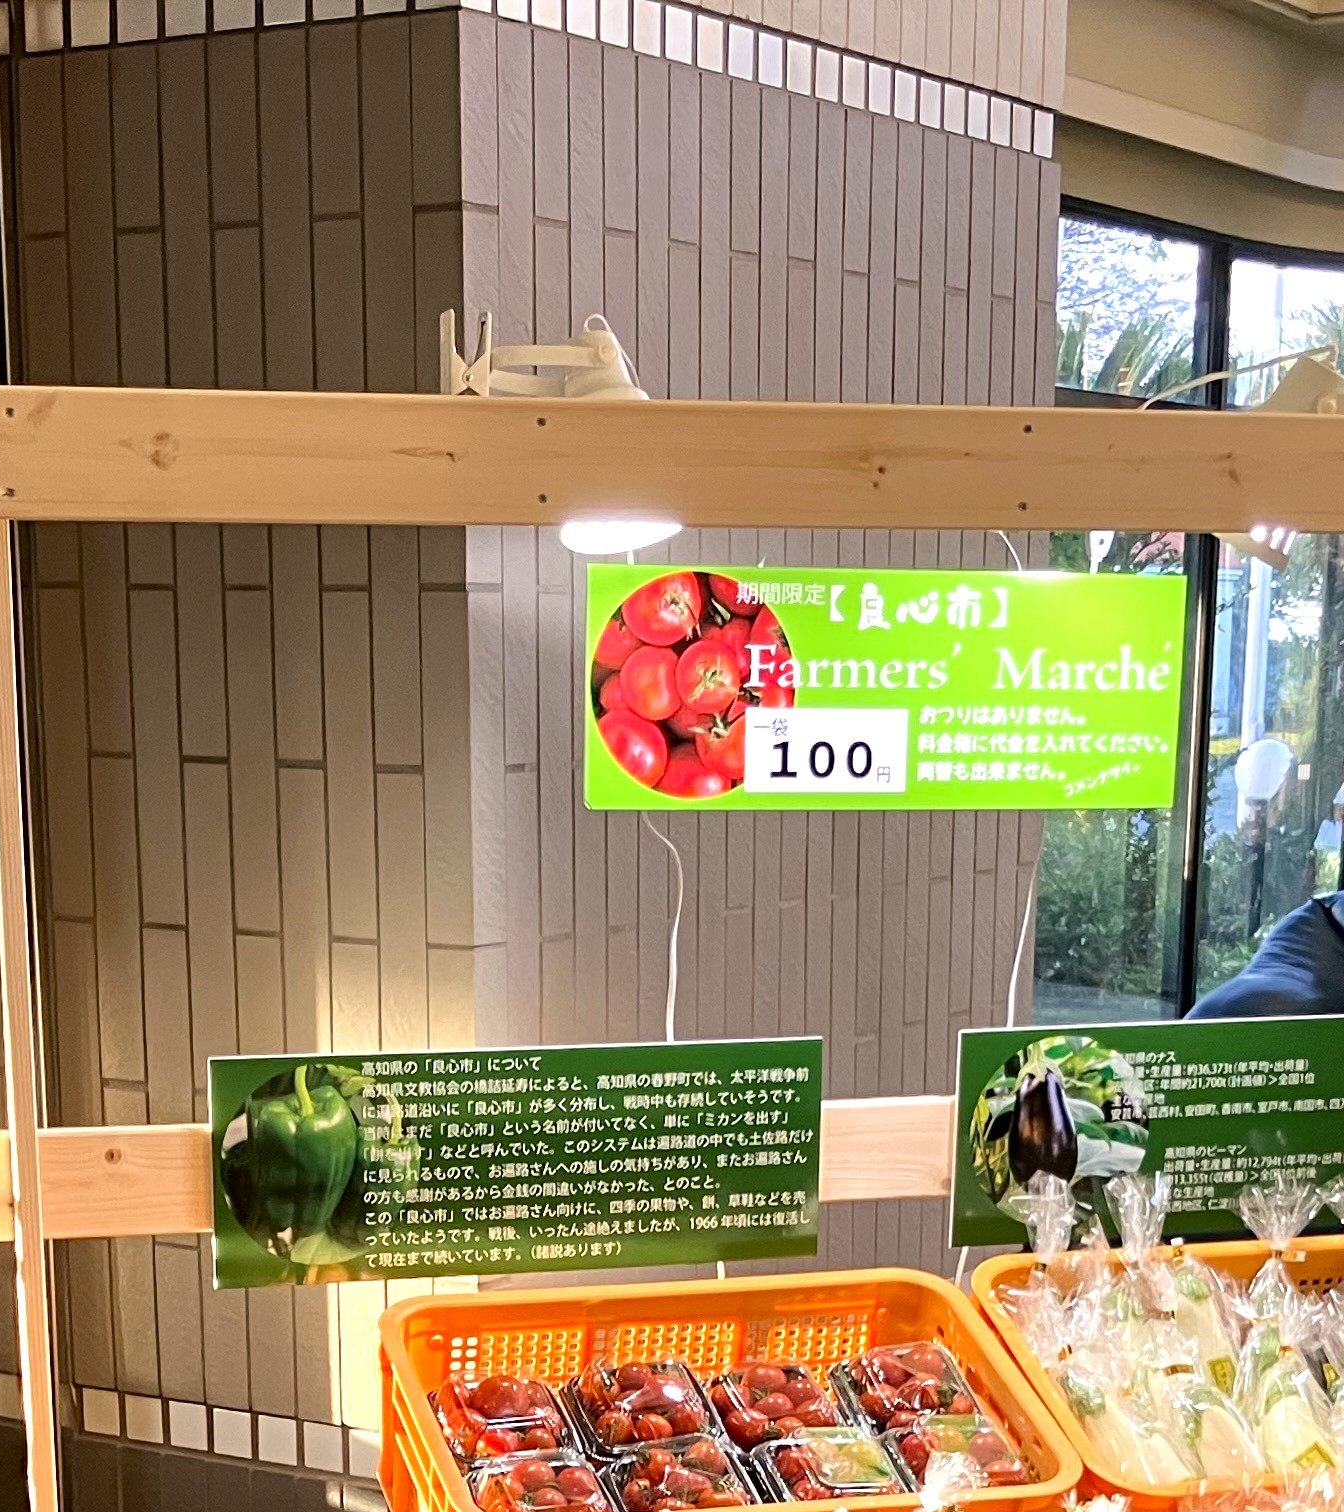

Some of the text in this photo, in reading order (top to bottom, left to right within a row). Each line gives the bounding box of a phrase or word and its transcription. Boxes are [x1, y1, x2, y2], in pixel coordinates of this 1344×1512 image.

[736, 582, 1008, 630] 期間限定 【良心市】
[992, 640, 1171, 691] Marché
[919, 705, 1086, 725] おつりはありません。
[753, 717, 789, 738] 一袋
[917, 733, 1169, 753] 料金箱に代金を入れてください。
[770, 740, 892, 784] 100 円
[917, 761, 1066, 781] 両替も出来ません。
[361, 1056, 542, 1076] 高知県の「良心市」について
[363, 1111, 789, 1141] 当時まだ「良心市」という名前が付いてなく、単に「ミカンを出す」
